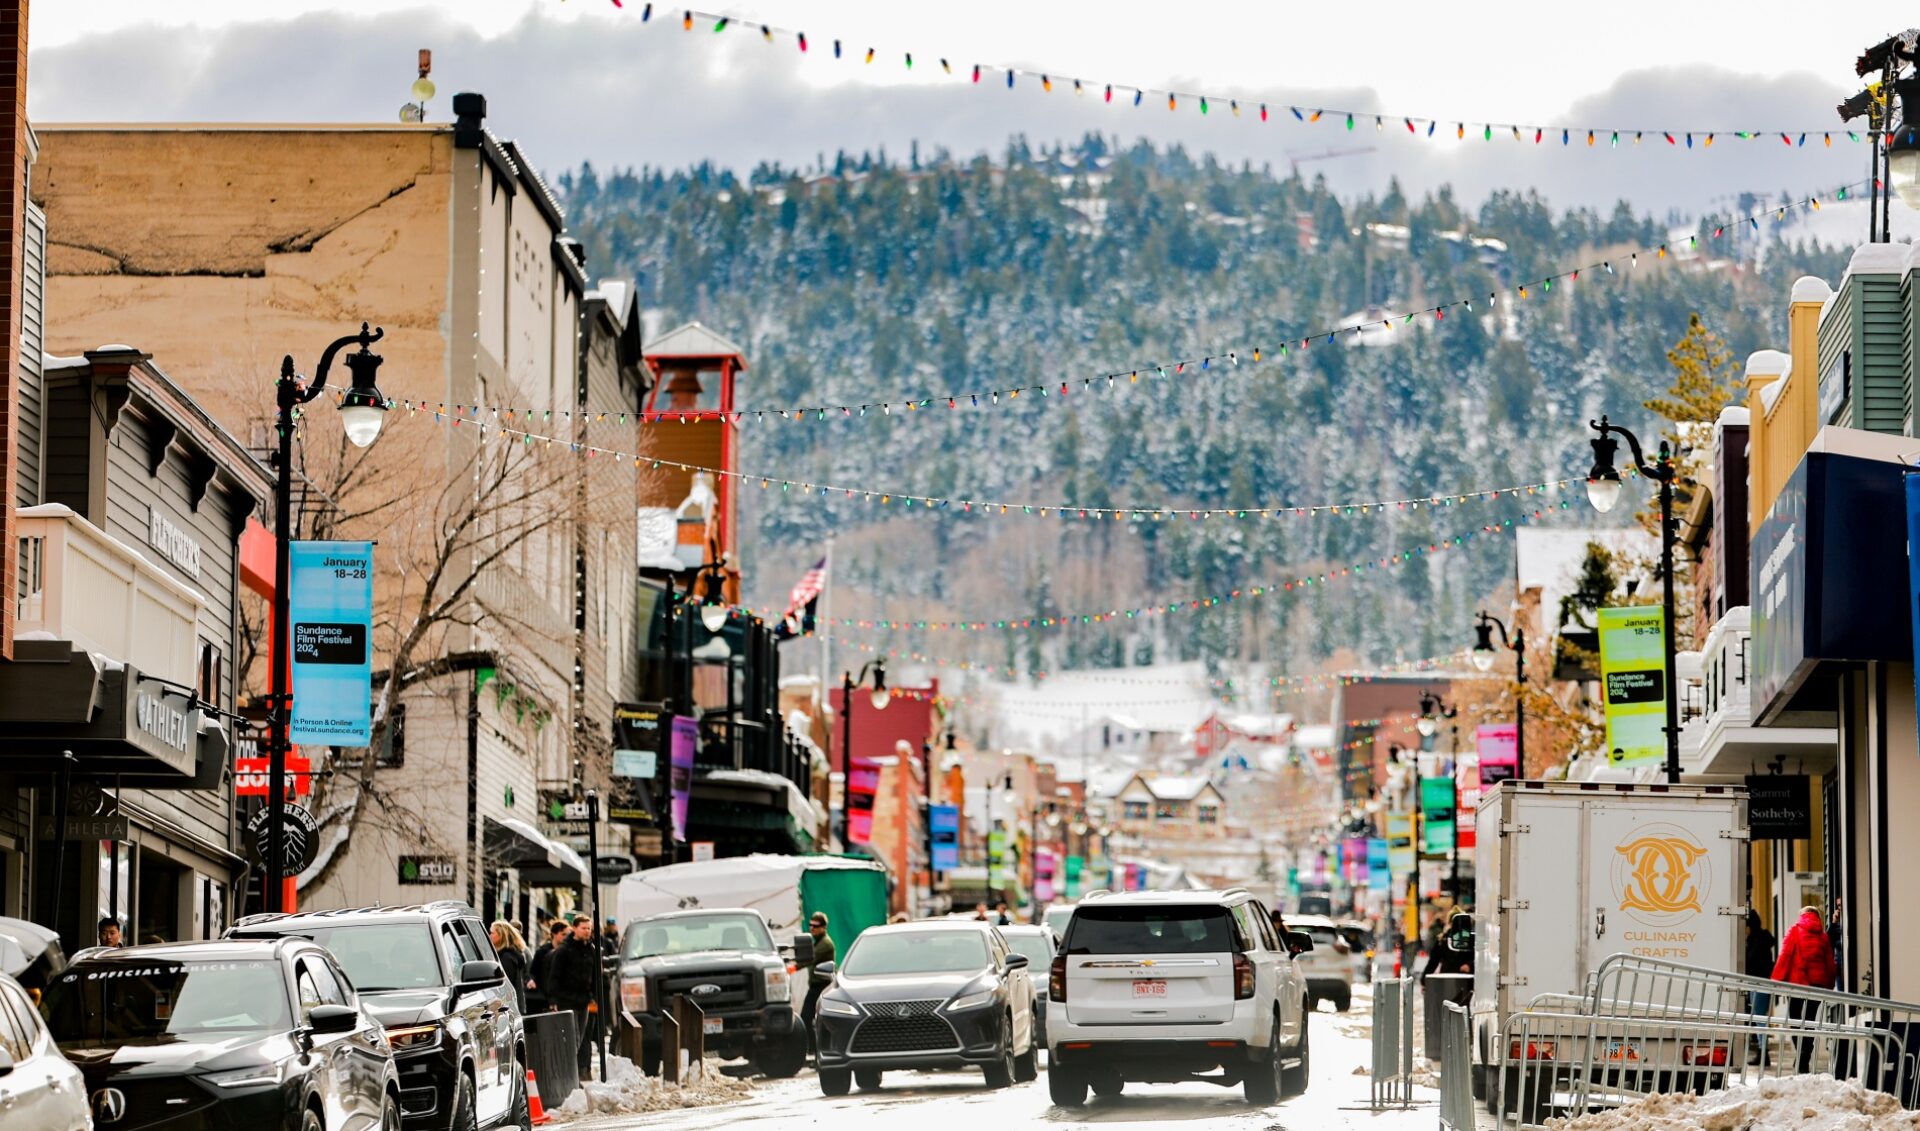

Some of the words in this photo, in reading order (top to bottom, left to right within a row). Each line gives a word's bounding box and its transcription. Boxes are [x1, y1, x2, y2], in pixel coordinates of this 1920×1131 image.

[323, 557, 368, 569] January
[1624, 619, 1660, 627] January
[297, 625, 343, 635] Sundance
[296, 635, 316, 643] Film
[318, 635, 353, 645] Festival
[296, 644, 319, 657] 2024
[1609, 674, 1646, 682] Sundance
[1609, 681, 1626, 689] Film
[1626, 680, 1655, 688] Festival
[1610, 688, 1629, 699] 2024
[144, 694, 188, 754] ATHLETA
[300, 718, 324, 726] Person
[330, 719, 353, 727] Online
[632, 719, 659, 730] Lodge
[293, 725, 365, 736] festival.sundance.org
[247, 803, 317, 833] FLEHER'S
[1751, 807, 1805, 821] Sotheby's
[45, 823, 123, 836] AHLETA
[1623, 931, 1697, 942] CULINARY
[1631, 947, 1690, 958] CRAFTS
[88, 968, 162, 980] OFFICIAL
[169, 963, 239, 974] VEHICLE
